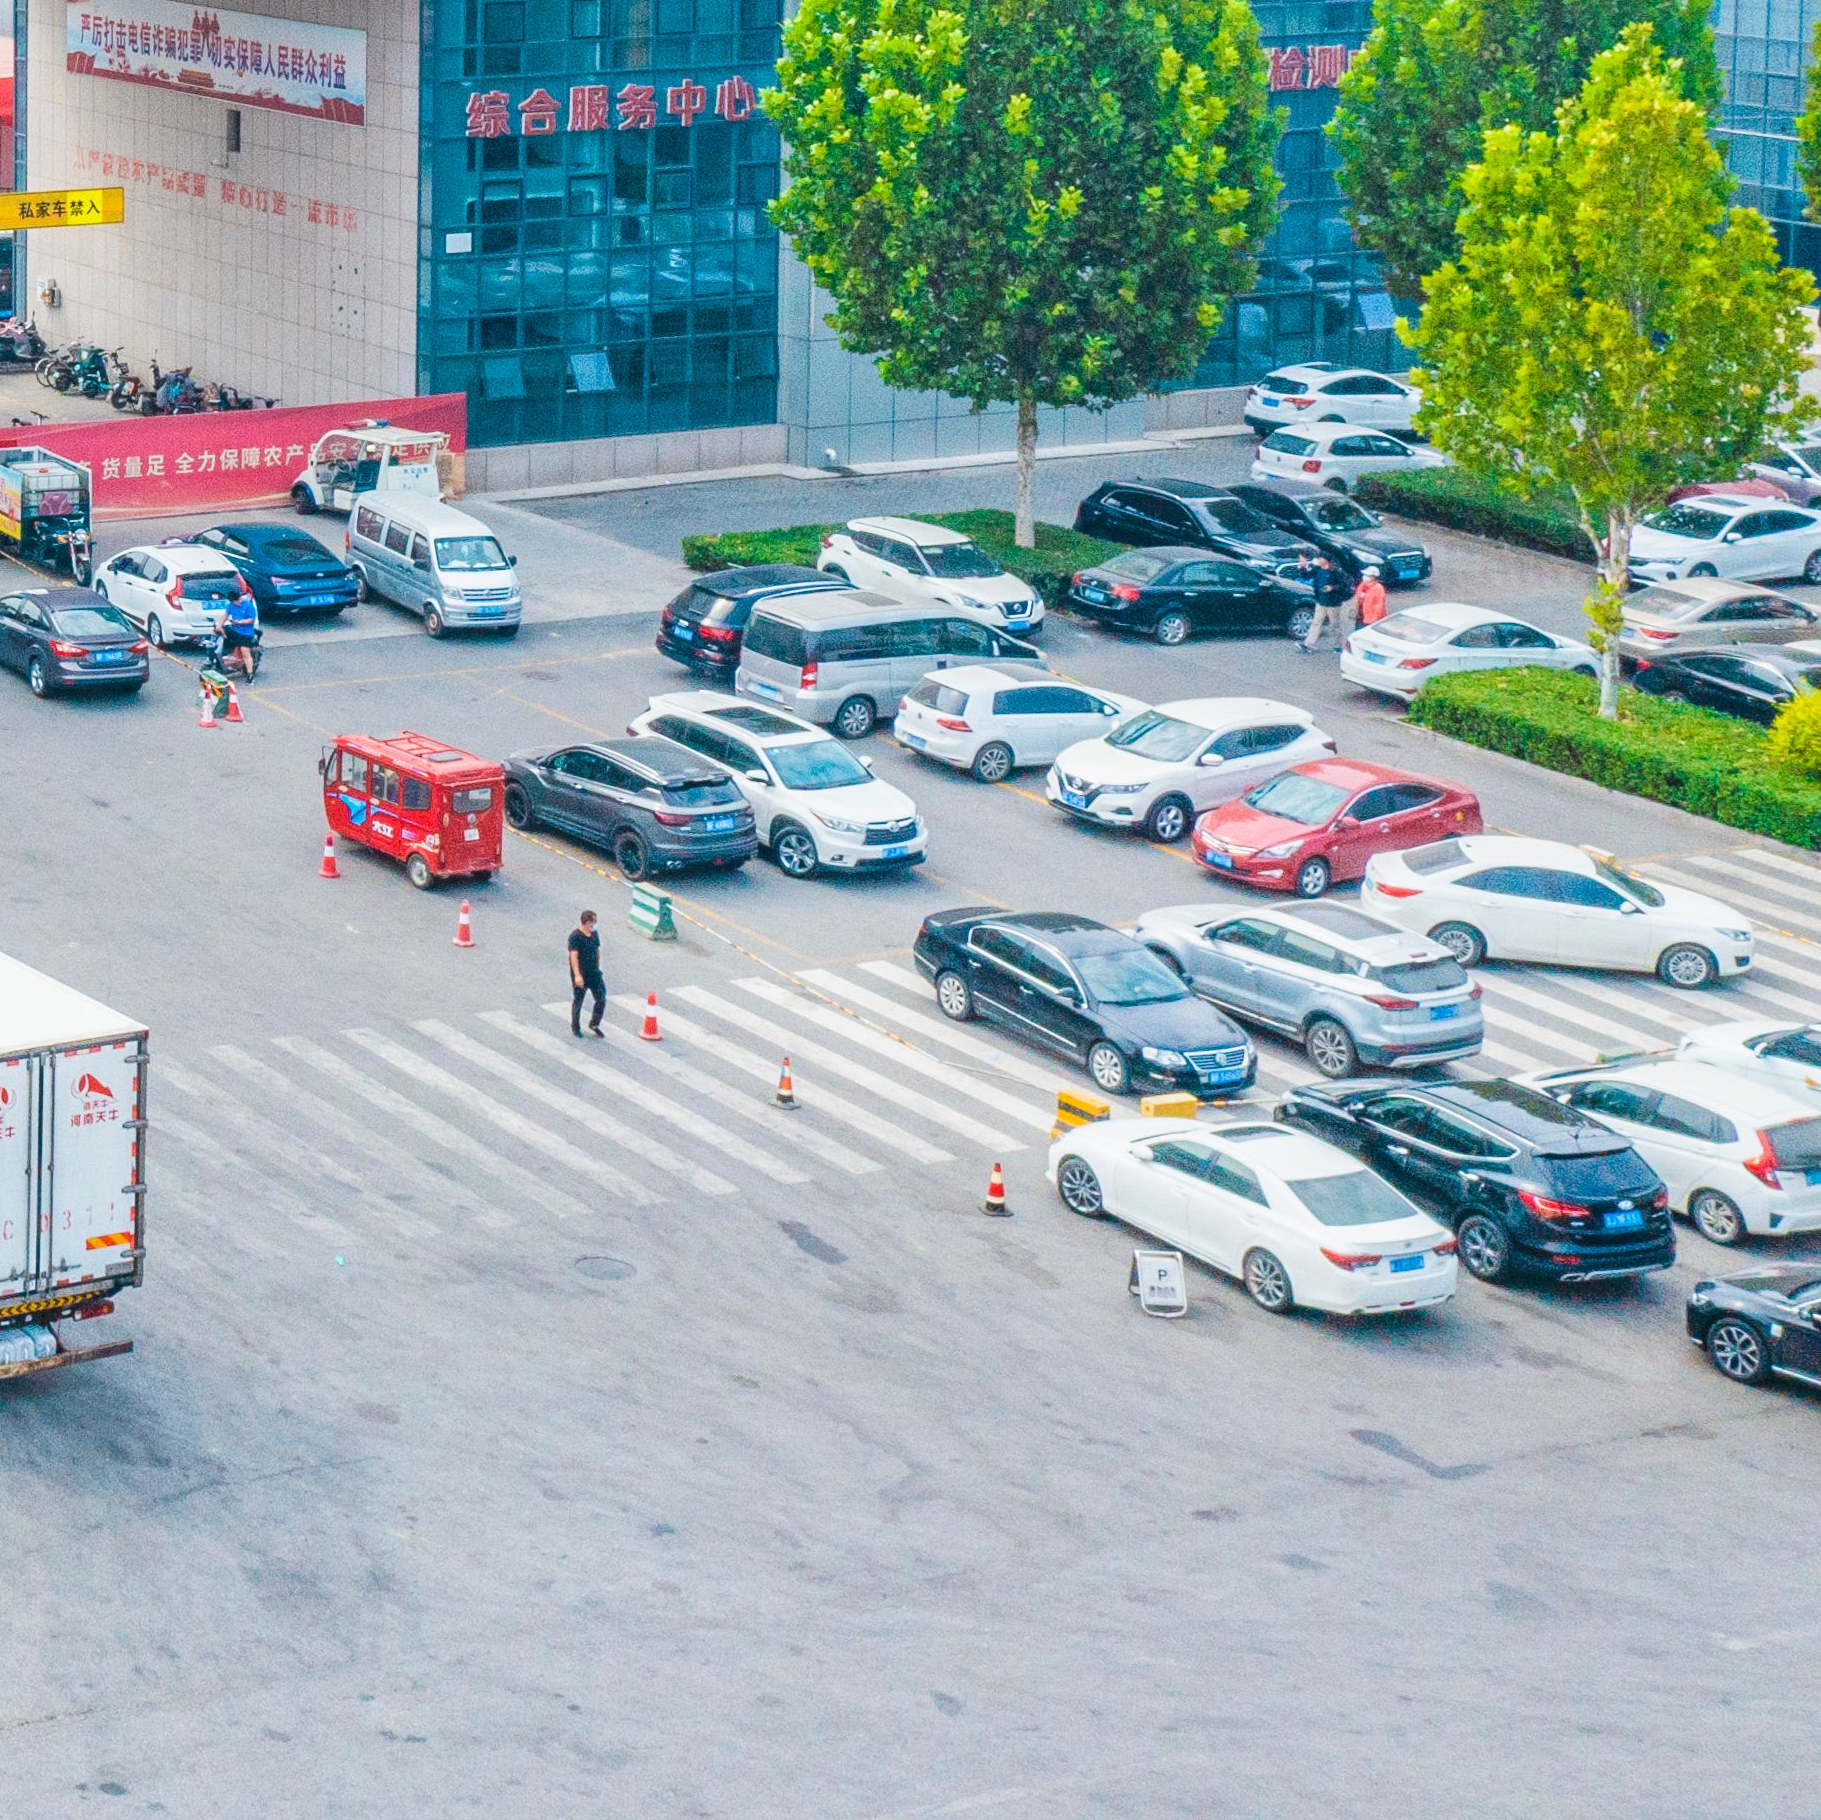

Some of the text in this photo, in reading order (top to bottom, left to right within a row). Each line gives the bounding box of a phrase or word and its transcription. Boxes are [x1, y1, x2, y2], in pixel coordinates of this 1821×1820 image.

[465, 75, 756, 138] 综合服务中心
[18, 197, 101, 220] 私家车禁入
[100, 455, 166, 480] 货量足
[70, 1109, 119, 1128] 河南天牛
